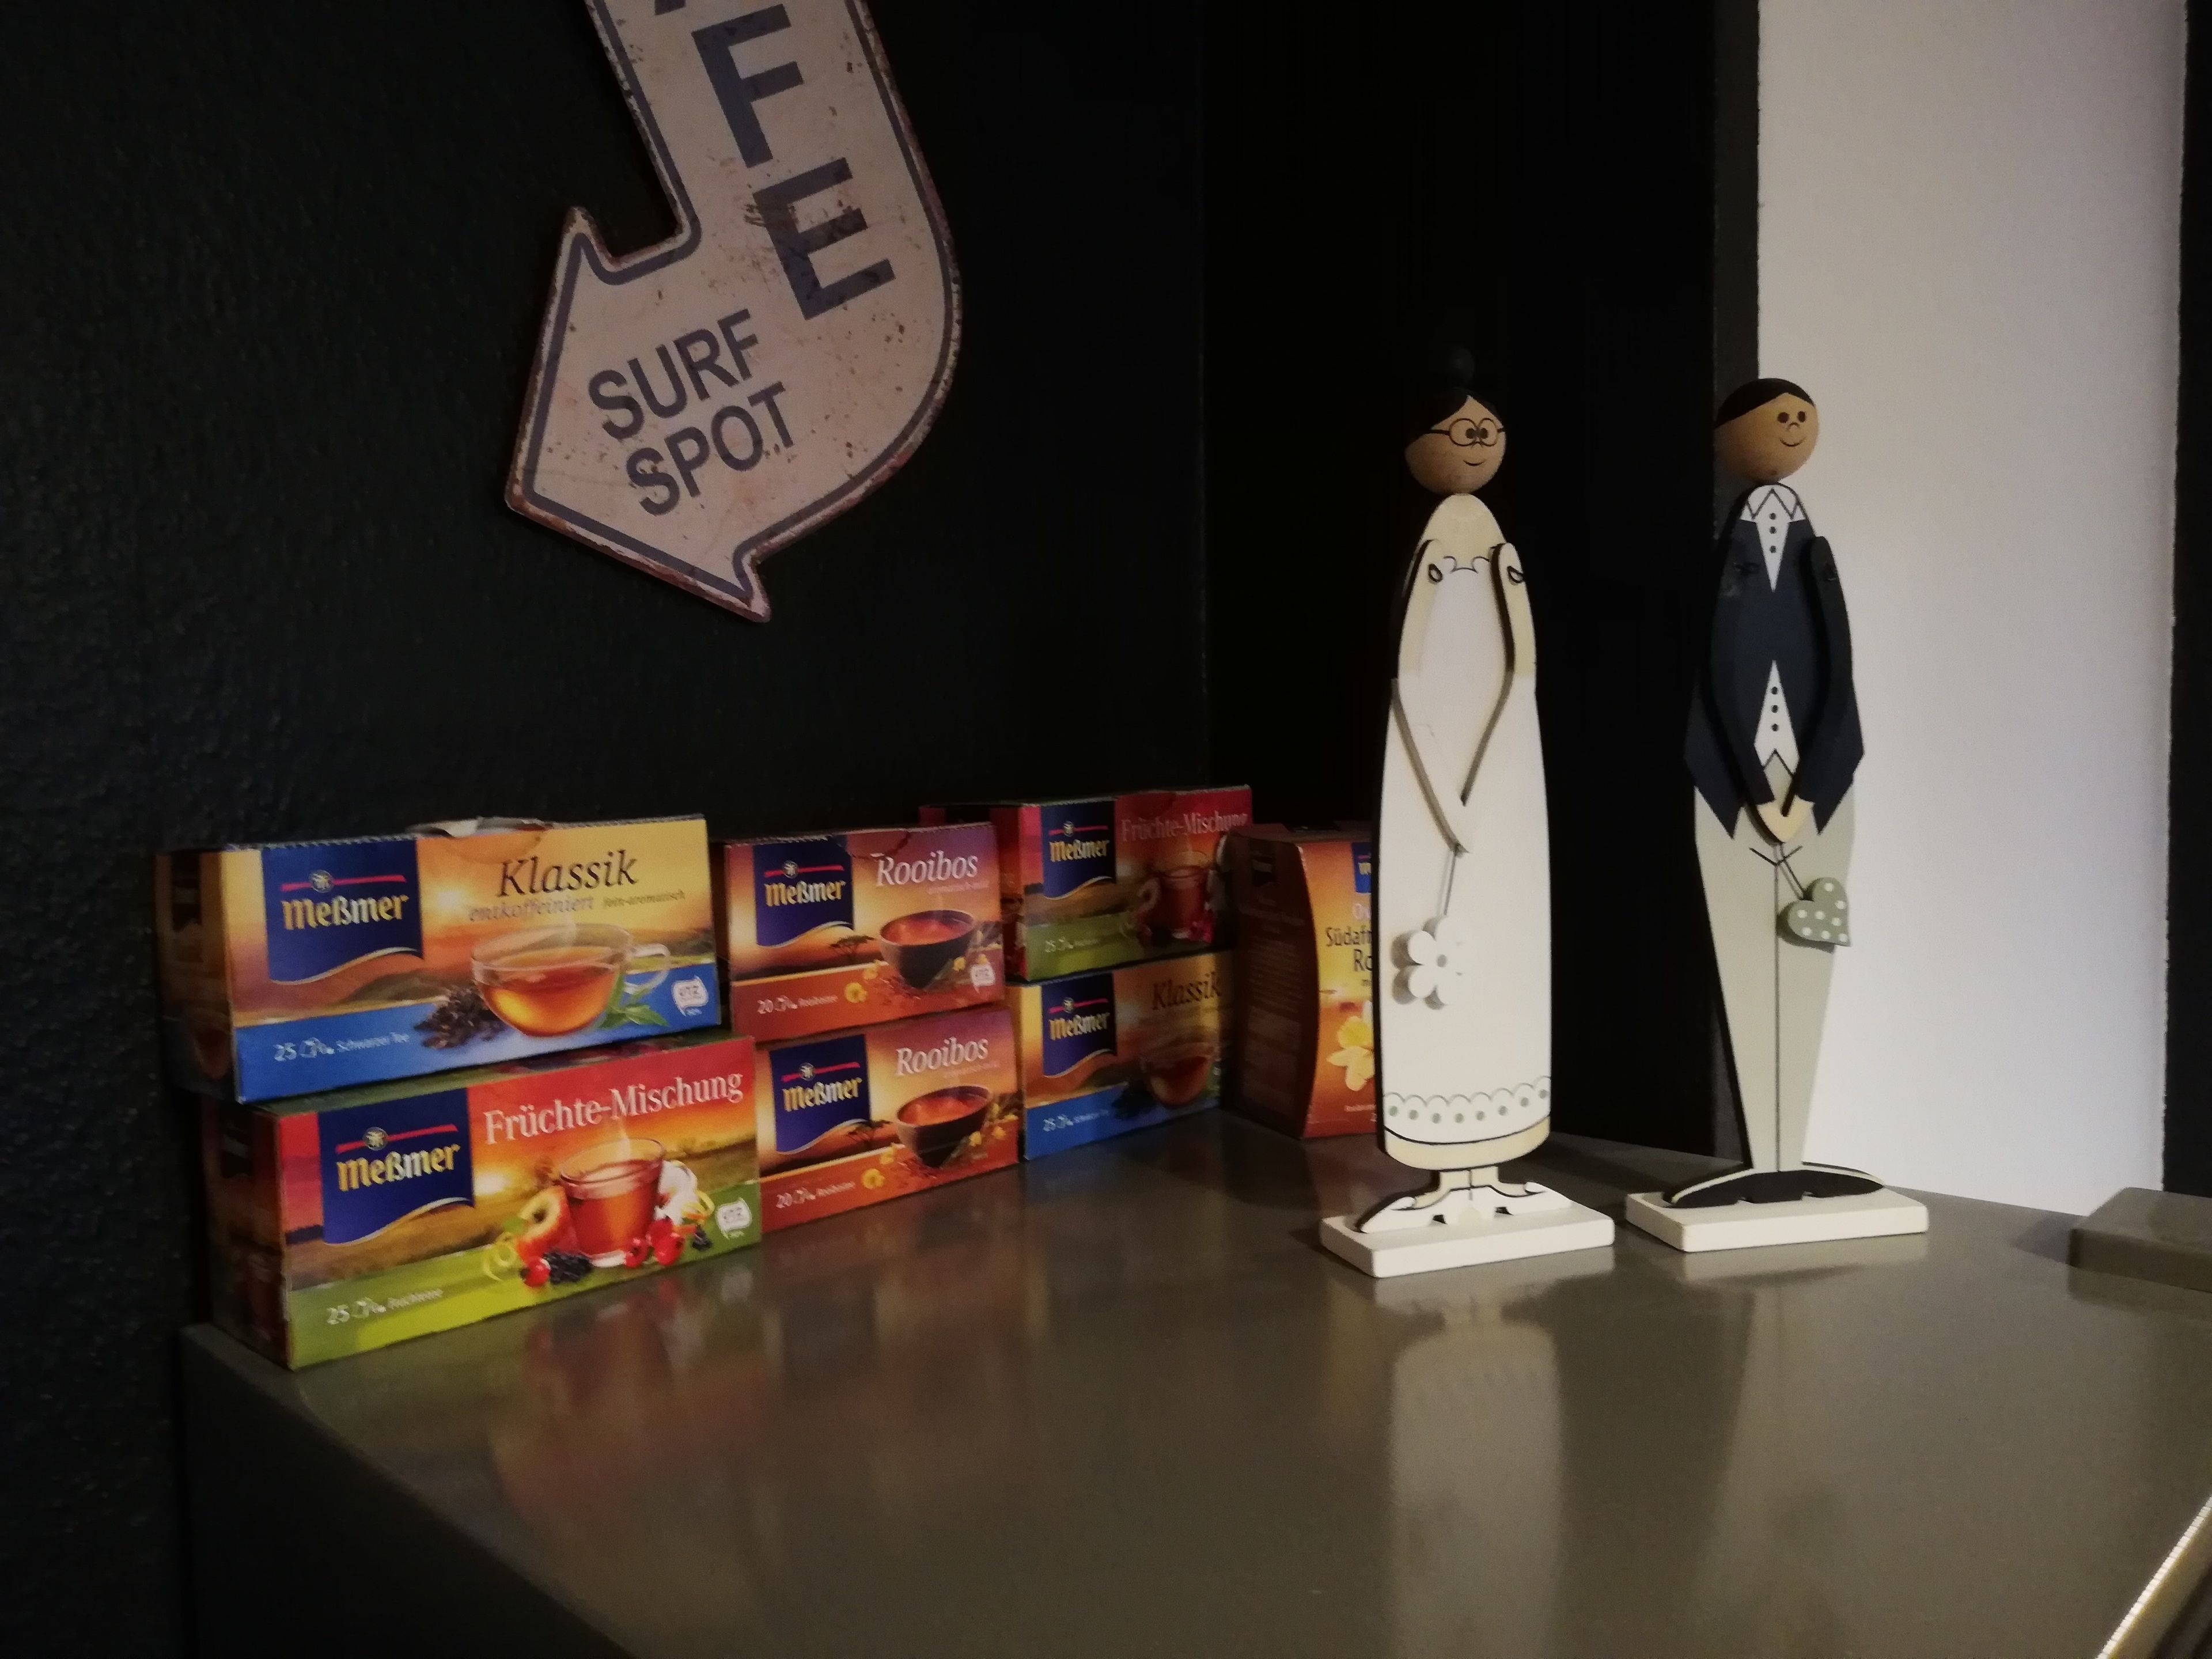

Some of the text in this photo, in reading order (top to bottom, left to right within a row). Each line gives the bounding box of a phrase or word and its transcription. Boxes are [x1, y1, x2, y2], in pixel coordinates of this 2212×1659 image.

[654, 0, 896, 320] FE
[586, 308, 759, 440] SURF
[625, 381, 794, 516] SPOT
[496, 849, 638, 897] Klassik
[876, 850, 979, 888] Rooibos
[1152, 971, 1222, 1010] Klassik
[272, 1042, 297, 1062] 25
[895, 1036, 989, 1077] Rooibos
[483, 1073, 744, 1145] Früchte-Mischung
[327, 1304, 351, 1325] 25
